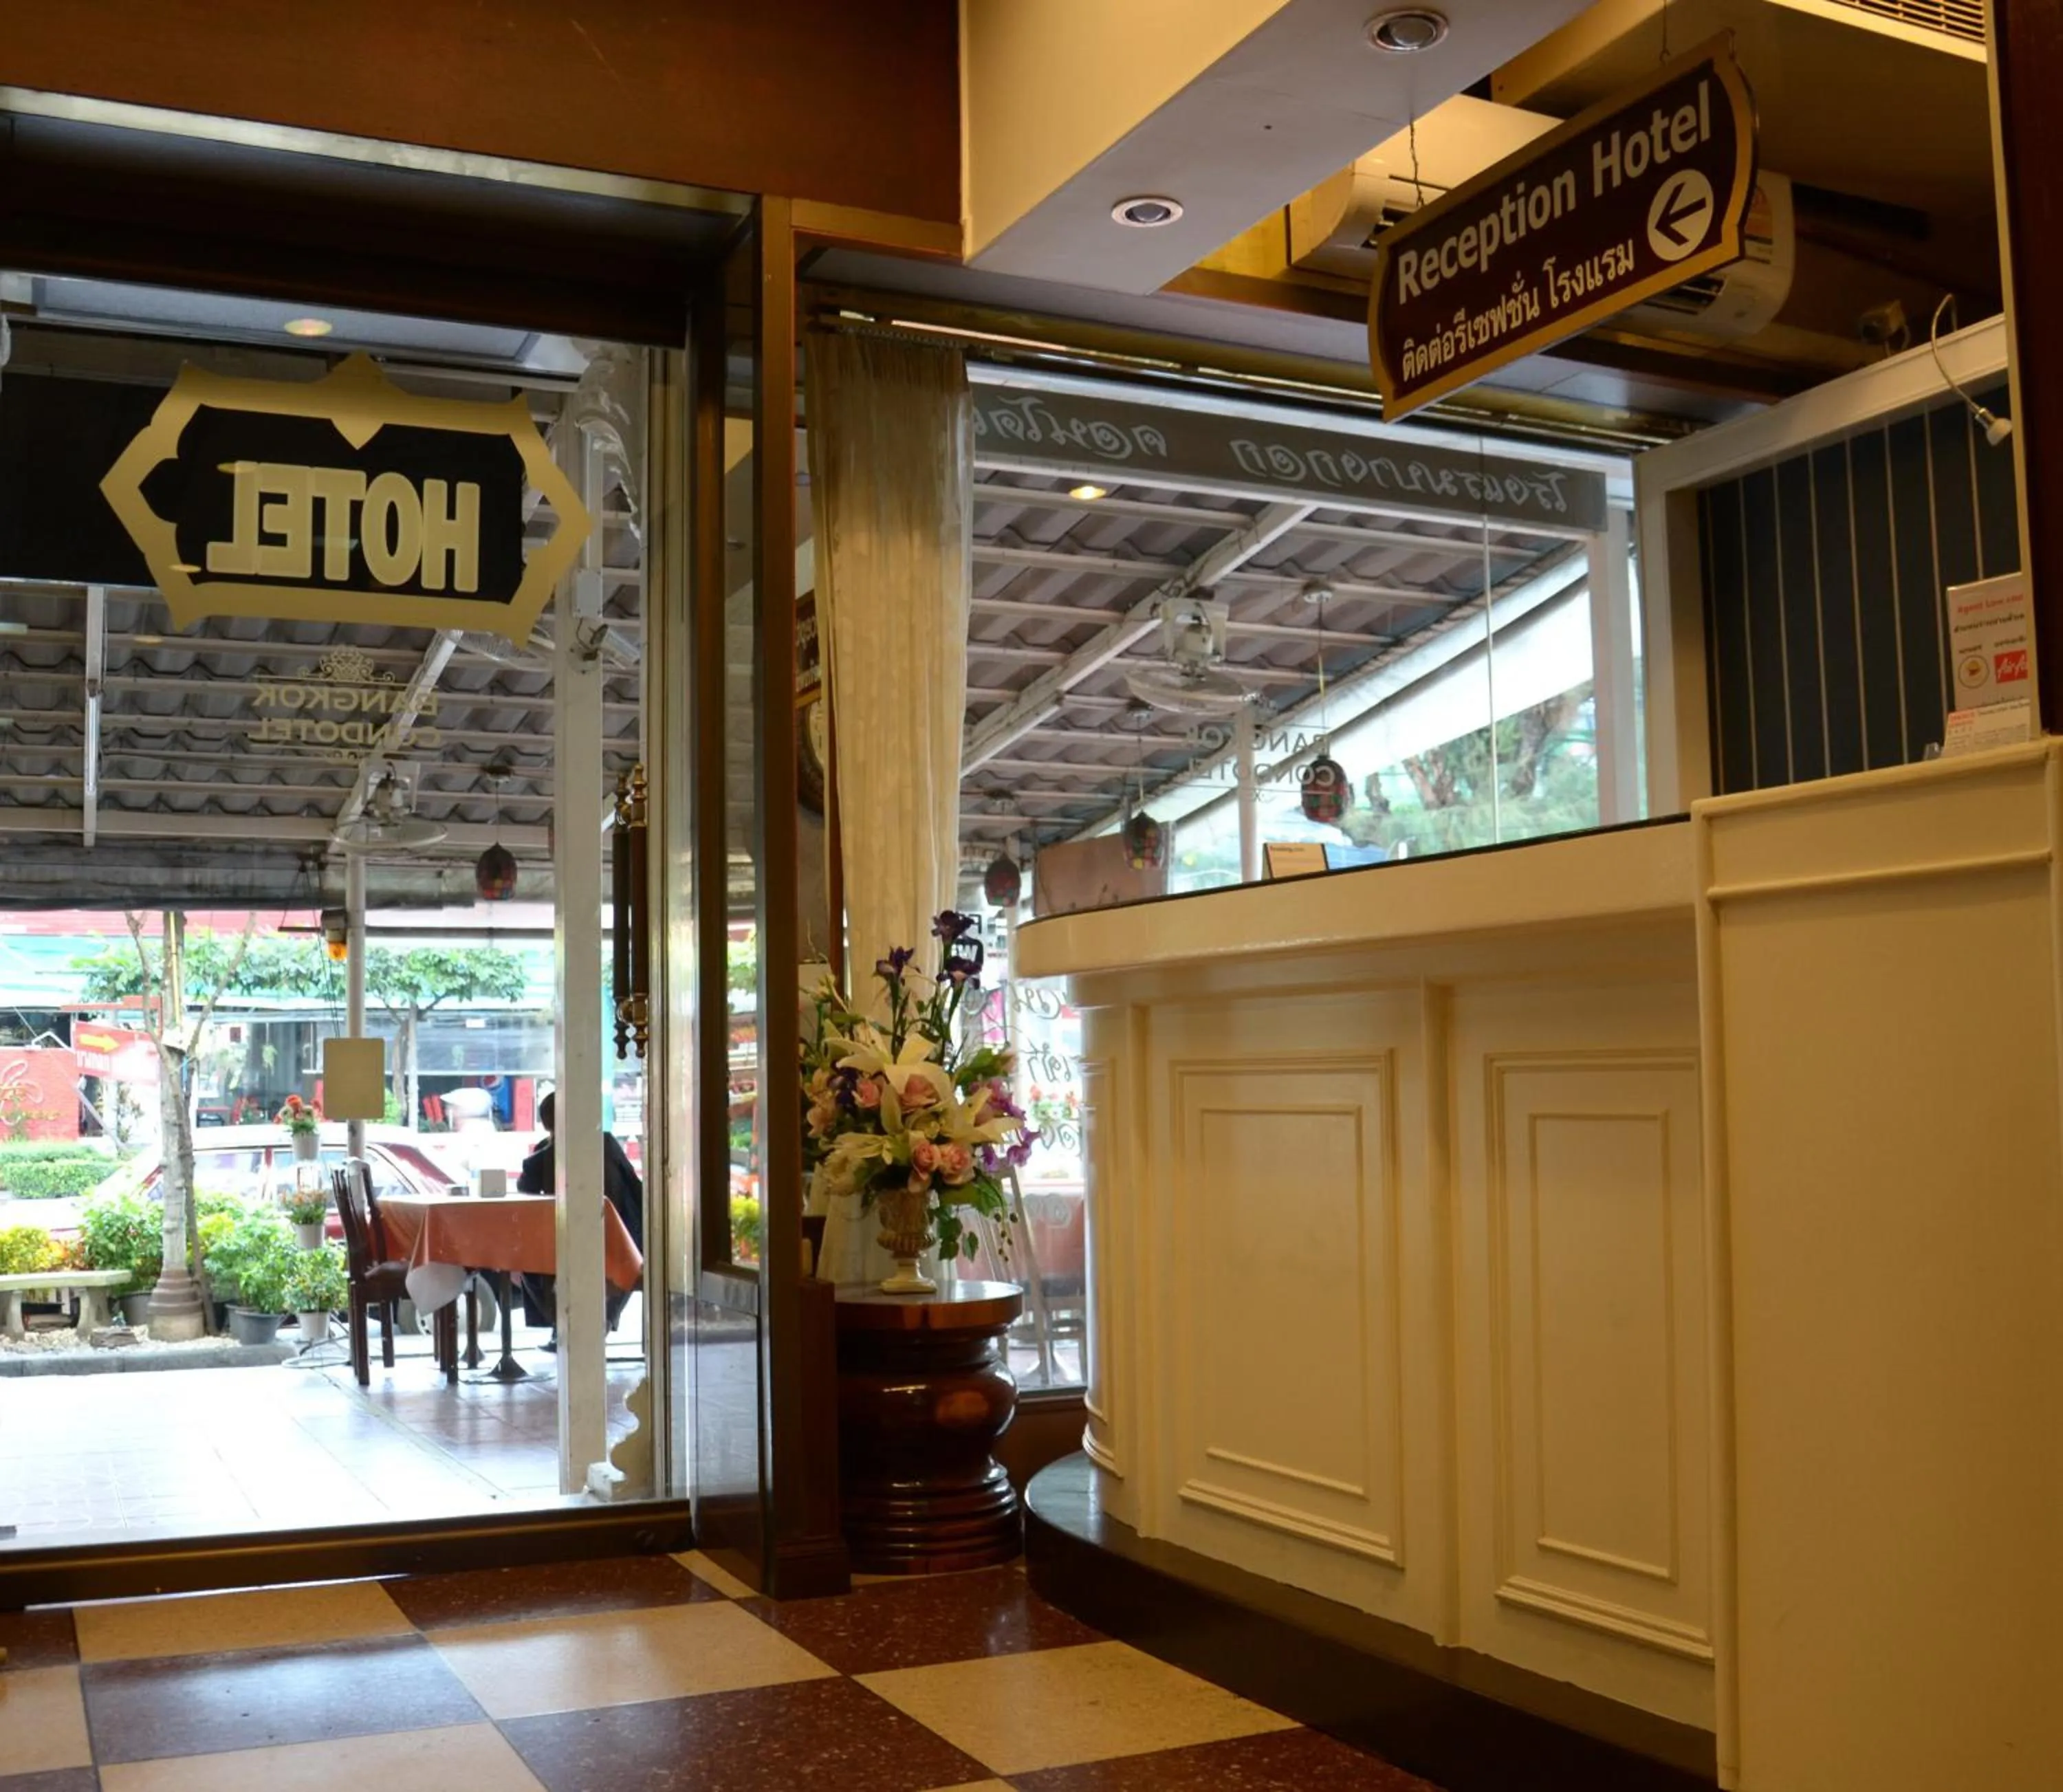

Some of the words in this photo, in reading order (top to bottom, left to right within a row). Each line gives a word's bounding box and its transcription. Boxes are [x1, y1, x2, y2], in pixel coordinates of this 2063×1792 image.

[1398, 169, 1576, 305] Reception
[1593, 80, 1711, 197] Hotel
[1542, 239, 1634, 308] โรงแรม
